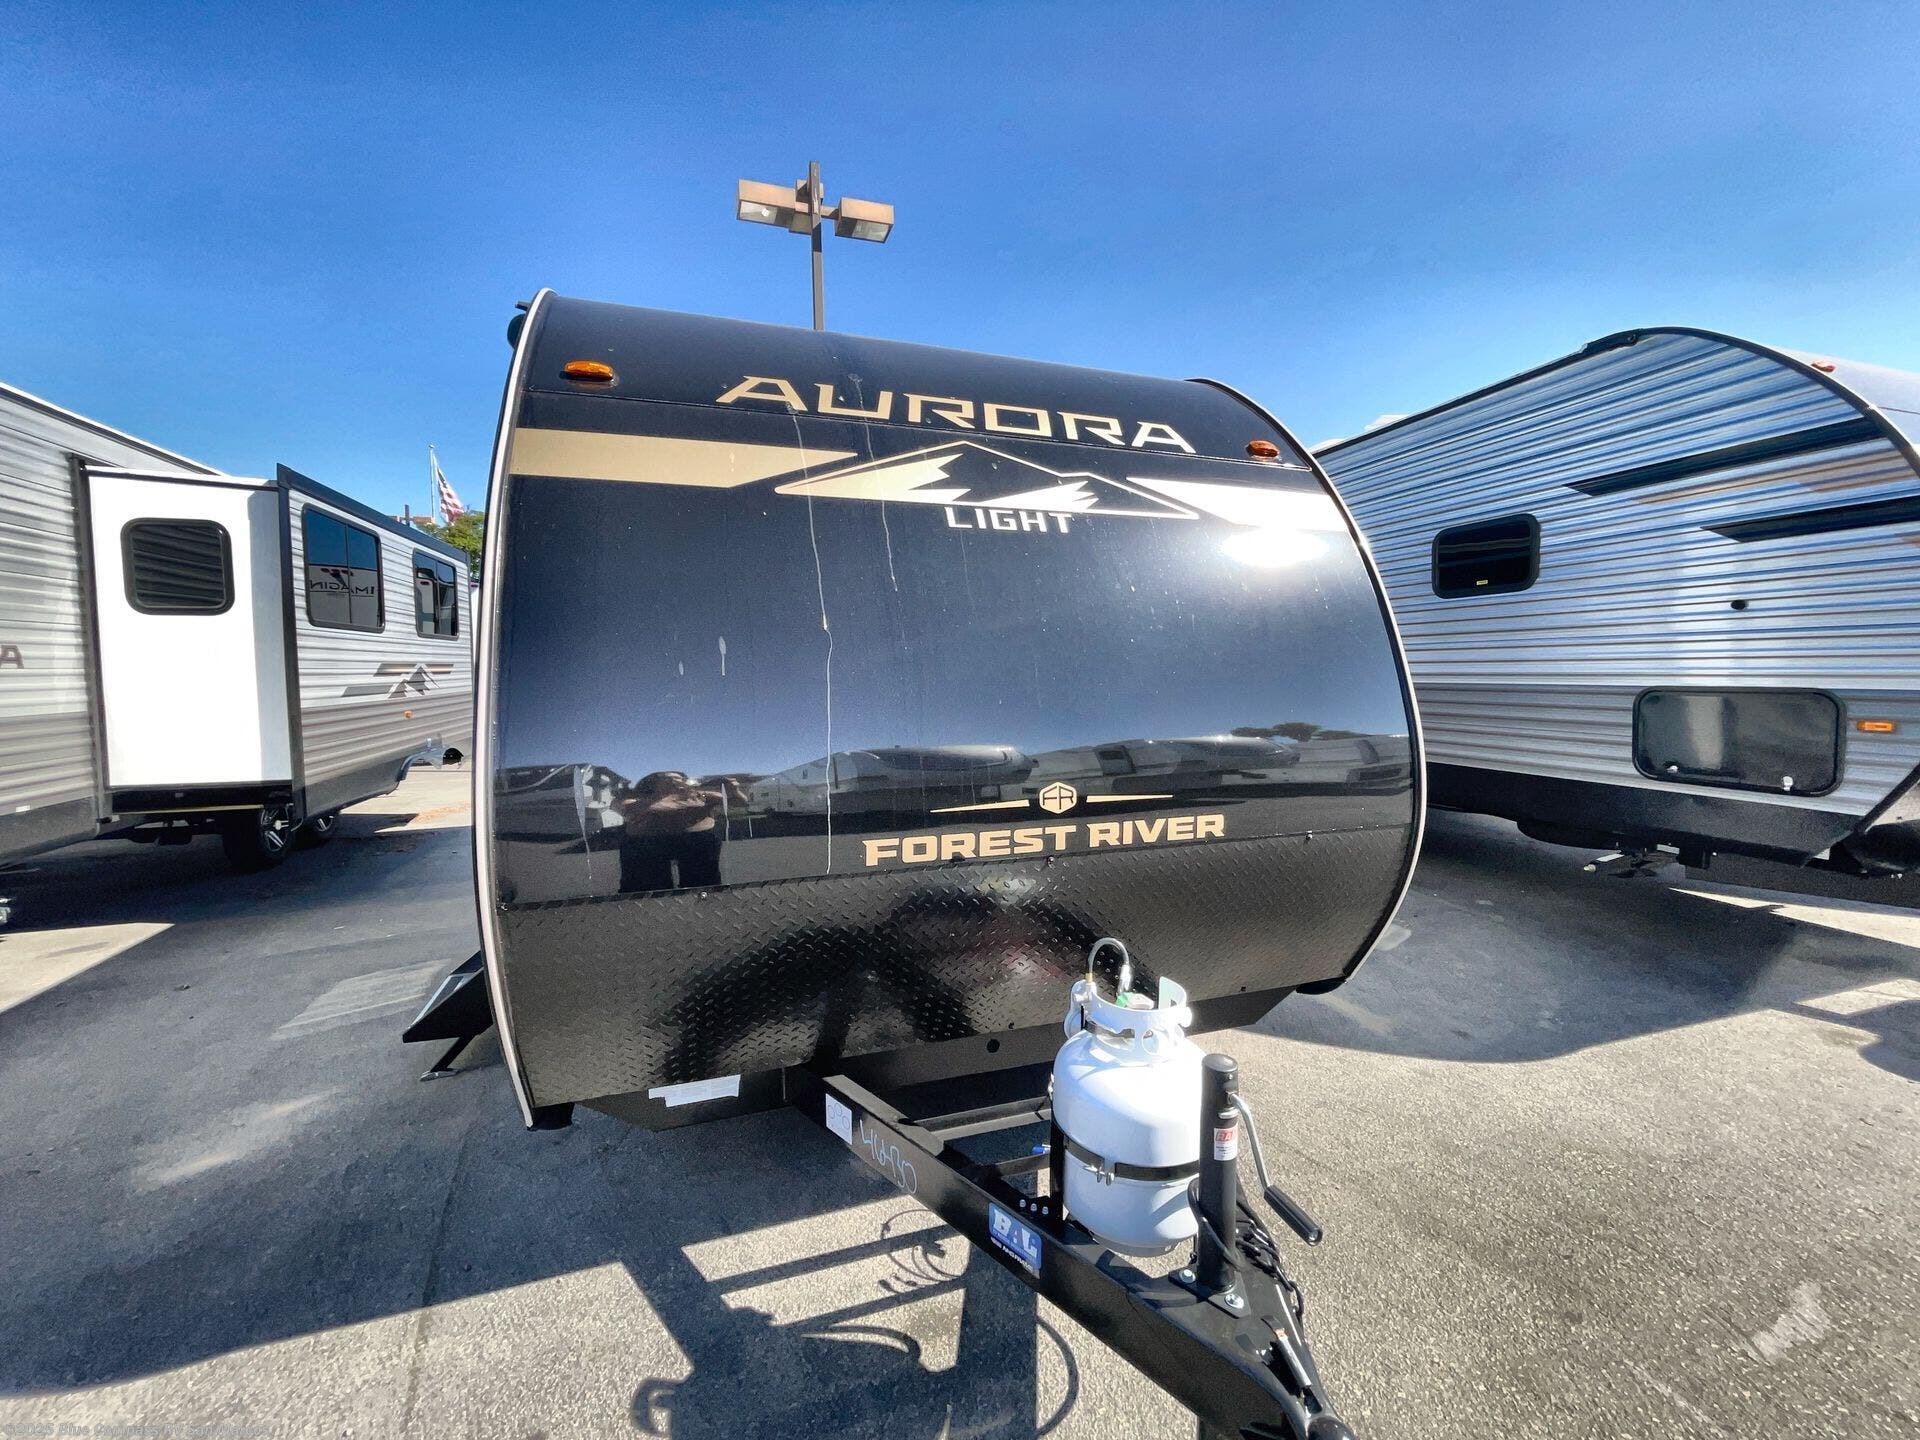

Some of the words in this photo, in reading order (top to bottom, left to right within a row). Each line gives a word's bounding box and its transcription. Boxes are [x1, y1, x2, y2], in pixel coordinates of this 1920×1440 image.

[716, 376, 1197, 454] AURORA
[944, 505, 1074, 535] LIGHT
[862, 824, 1078, 867] FOREST
[1086, 813, 1226, 848] RIVER
